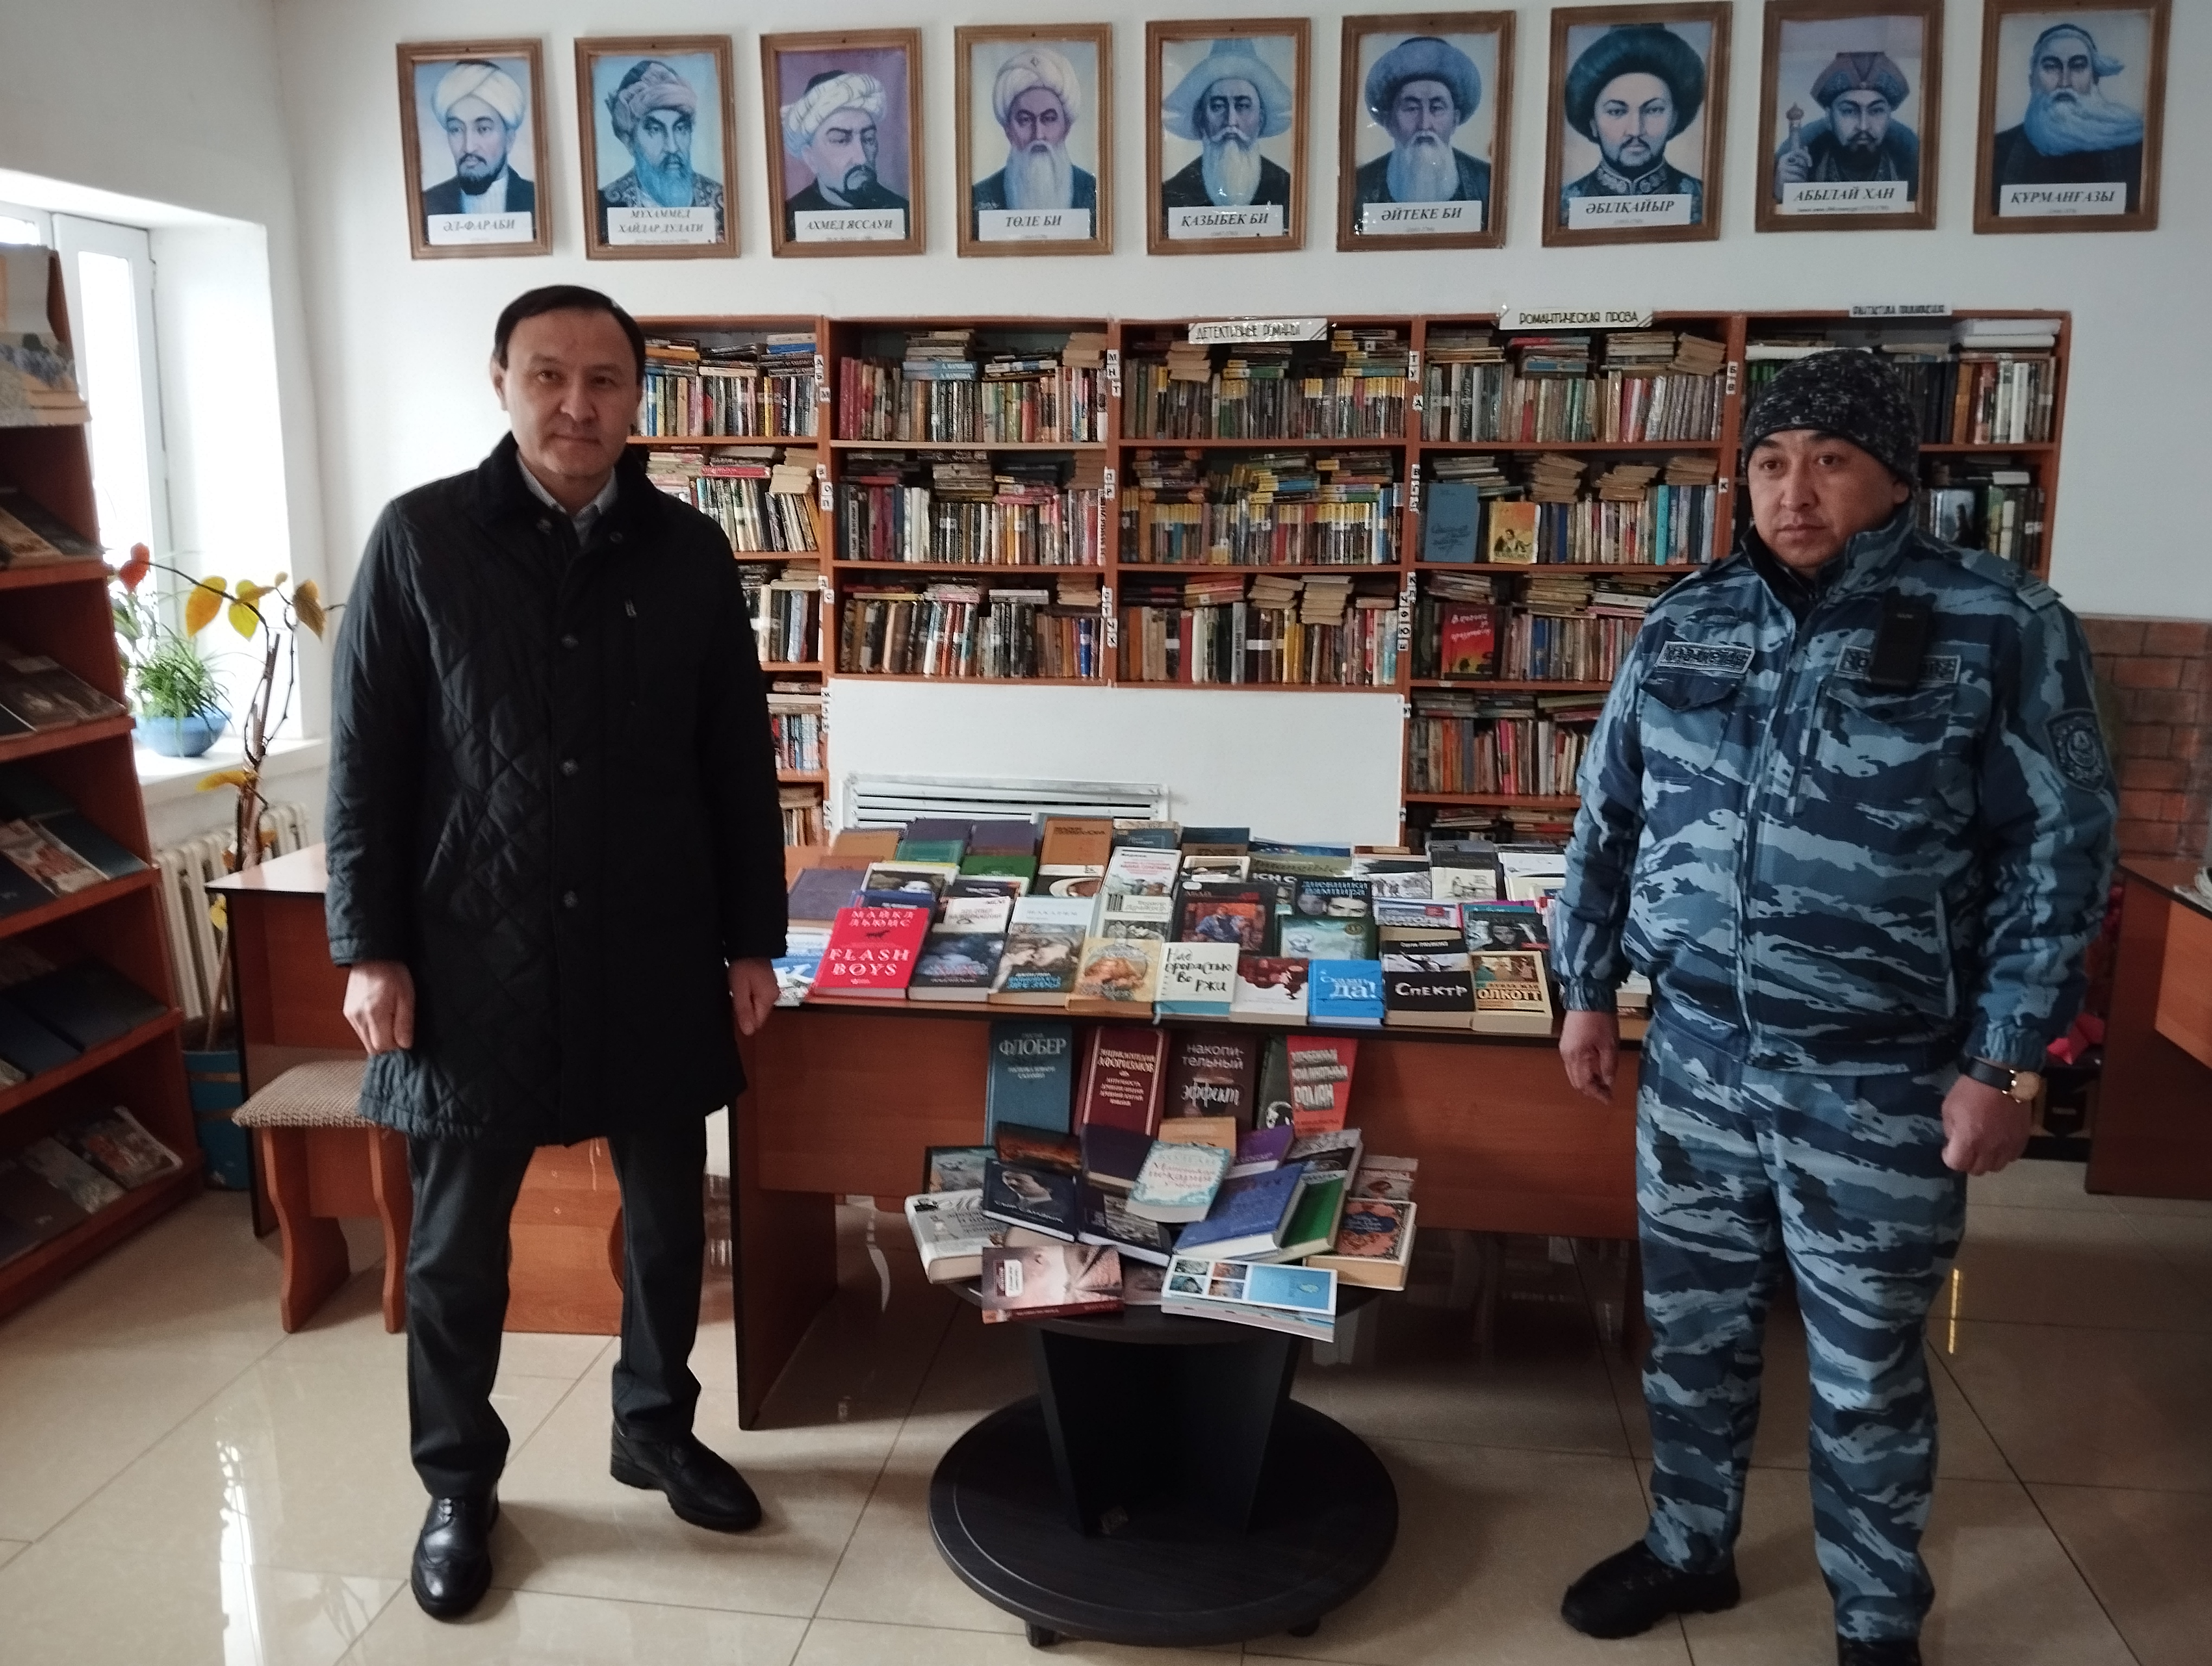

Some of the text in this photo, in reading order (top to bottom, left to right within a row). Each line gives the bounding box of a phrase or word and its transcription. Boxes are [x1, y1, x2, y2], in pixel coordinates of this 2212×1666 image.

[1796, 187, 1895, 202] АБЫЛАЙ ХАН
[1250, 213, 1268, 224] БИ
[1382, 207, 1461, 221] ӘЙТЕКЕ БИ
[1006, 215, 1061, 227] ТӨЛЕ БИ
[1606, 311, 1638, 323] ПРОЗА
[828, 949, 910, 961] FLASH
[832, 964, 897, 976] BOYS
[1477, 989, 1544, 1001] ОЛКОТТ
[999, 1038, 1066, 1055] ФЛОБЕР
[1182, 1056, 1243, 1069] тельный
[1181, 1081, 1240, 1108] эффект
